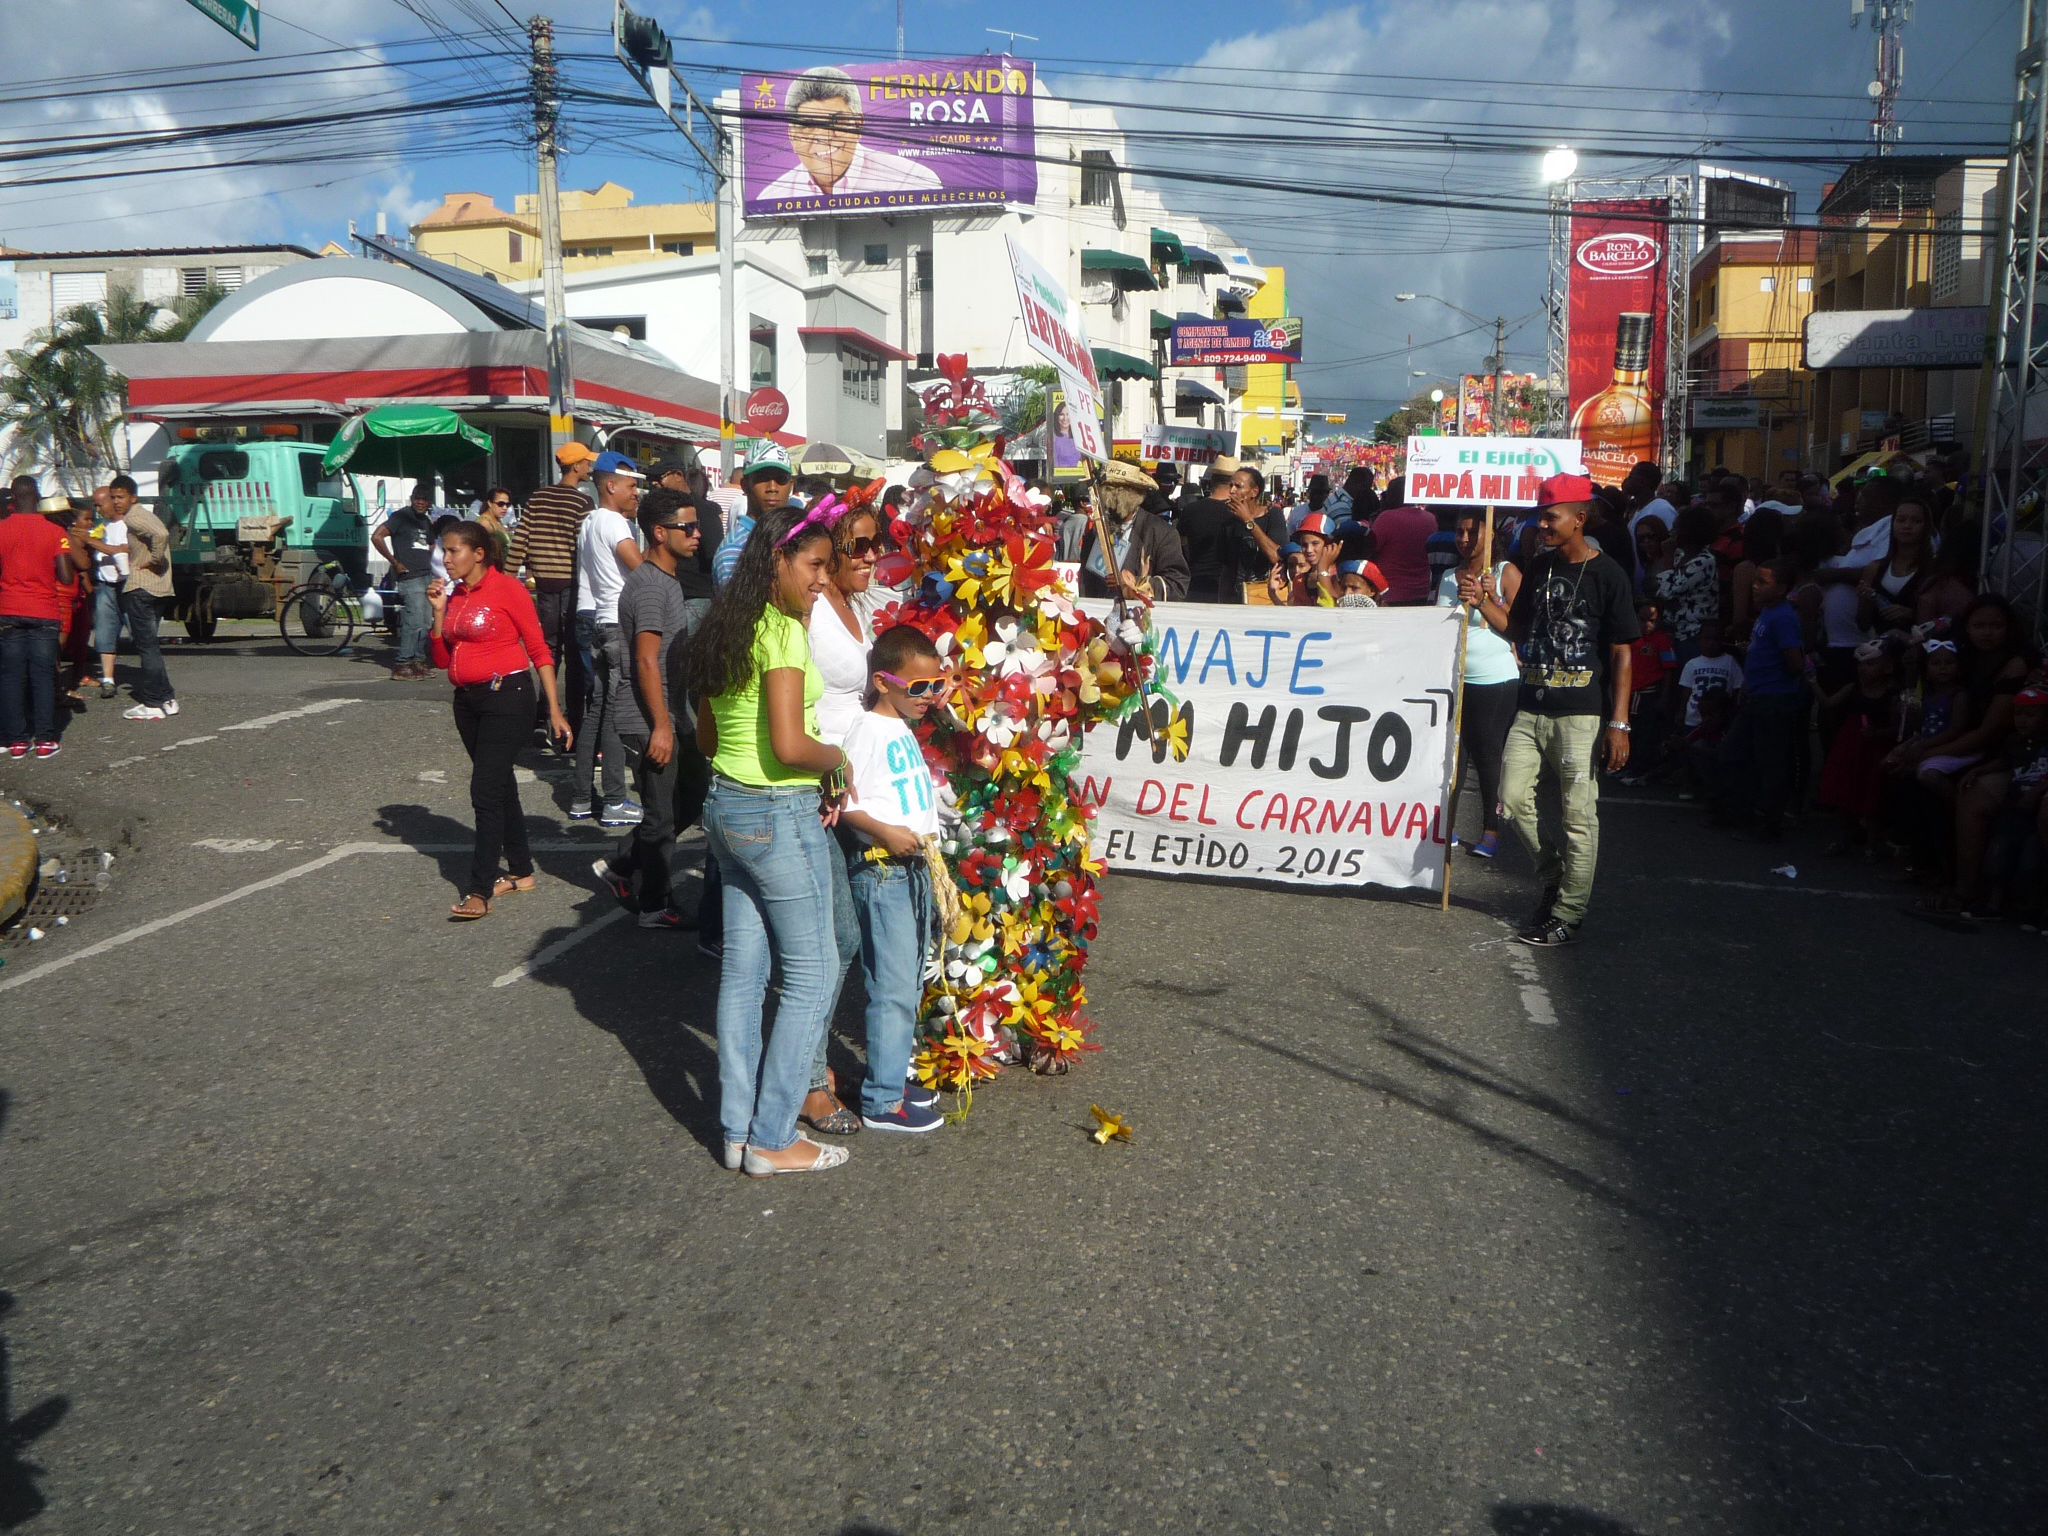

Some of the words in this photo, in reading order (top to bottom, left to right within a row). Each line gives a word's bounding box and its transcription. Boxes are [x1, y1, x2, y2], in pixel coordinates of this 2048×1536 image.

[869, 69, 1027, 100] FERNANDO
[754, 98, 776, 109] PLD
[909, 98, 990, 126] ROSA
[777, 202, 801, 211] POR
[828, 196, 880, 207] CIUDAD
[888, 195, 914, 204] QUE
[921, 191, 1007, 203] MERECEMOS
[1589, 247, 1649, 262] BARCELÓ
[1607, 242, 1632, 252] RON
[1176, 326, 1228, 337] COMPRAVENTA
[1177, 338, 1183, 348] Y
[1184, 338, 1210, 348] AGENTE
[1211, 338, 1221, 348] DE
[1223, 337, 1251, 347] CAMBIO
[1837, 331, 1920, 350] Santa
[1203, 354, 1267, 363] 809-724-9400
[1077, 421, 1097, 454] 15
[1145, 444, 1171, 461] LOS
[1599, 441, 1622, 452] RON
[1459, 449, 1479, 464] El
[1486, 449, 1549, 466] Ejido
[1582, 448, 1638, 464] BARCELÓ
[1411, 470, 1474, 498] PAPÁ
[1480, 474, 1511, 500] MI
[1517, 476, 1551, 501] HI
[1219, 701, 1413, 783] HIJO
[1136, 779, 1217, 826] DEL
[1235, 789, 1446, 845] CARNAVAL
[1105, 829, 1137, 861] EL
